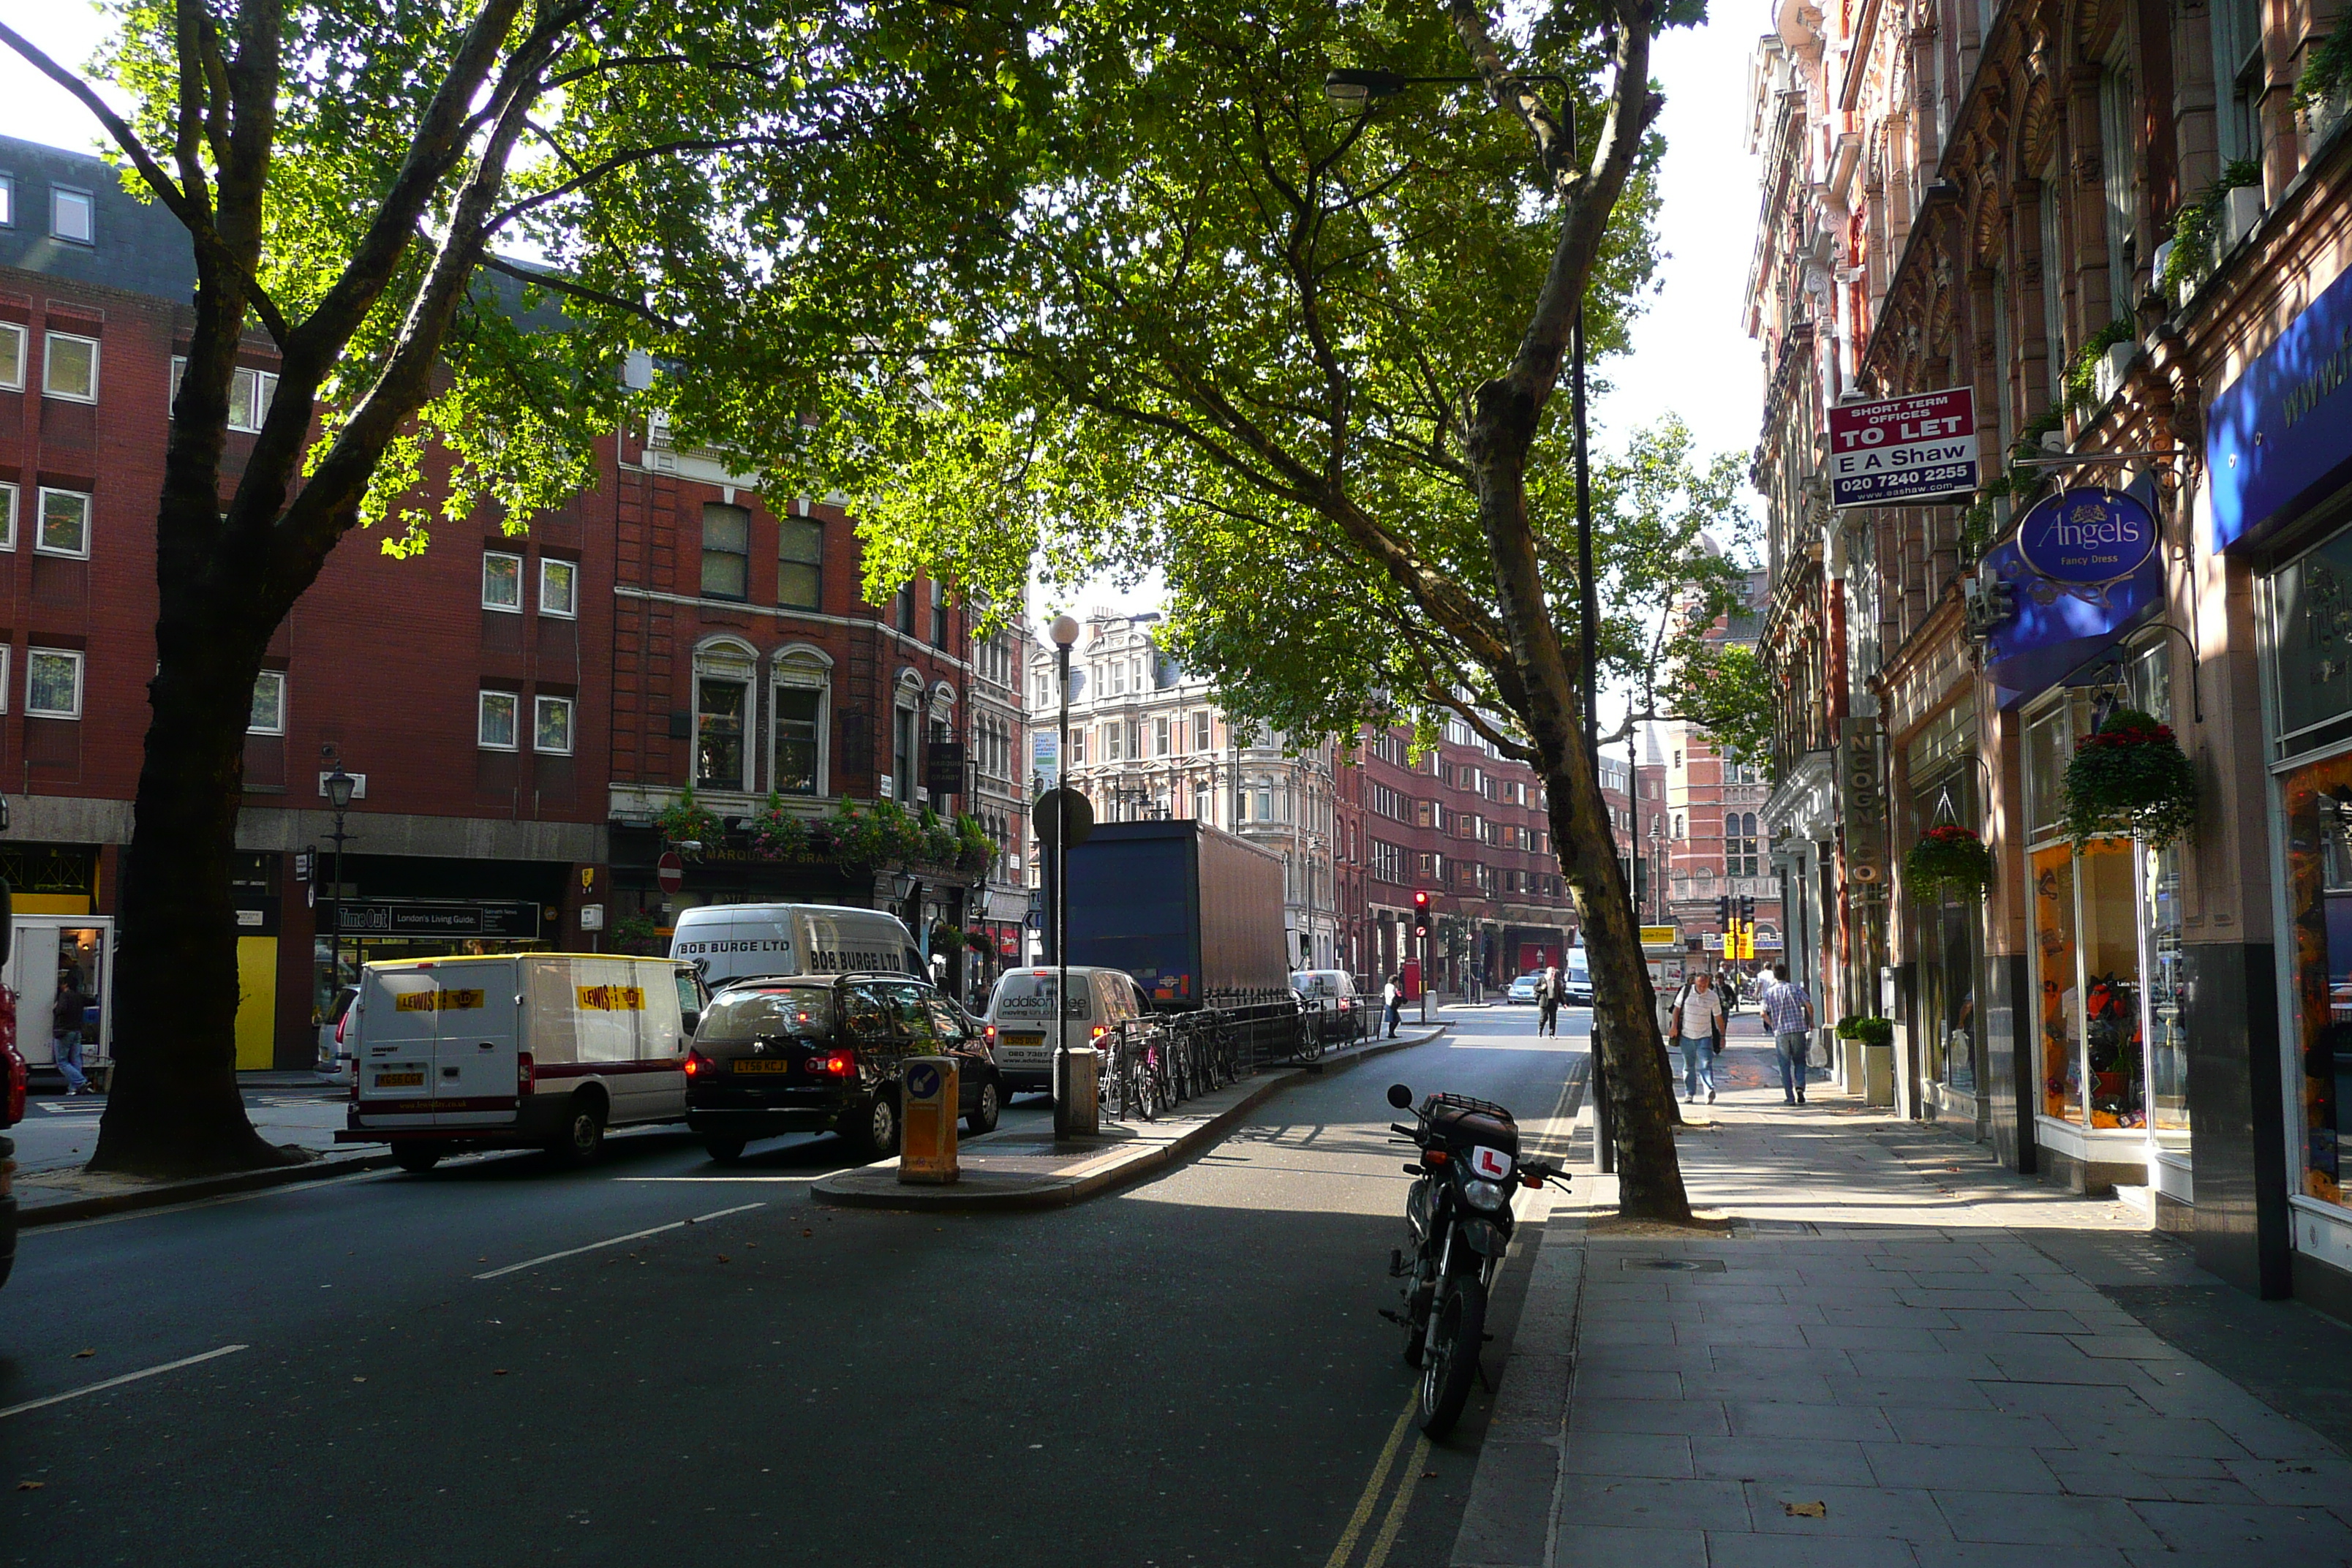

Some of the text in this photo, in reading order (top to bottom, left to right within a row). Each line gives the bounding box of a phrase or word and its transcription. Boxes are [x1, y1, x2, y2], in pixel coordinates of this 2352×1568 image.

[1851, 396, 1948, 418] SHORT TERM
[1869, 409, 1931, 424] OFFICES
[1839, 415, 1962, 448] TO LET
[1839, 445, 1966, 473] E A Shaw
[1842, 465, 1967, 492] 020 7240 2255
[1857, 483, 1953, 500] www.eashaw.com
[2036, 511, 2139, 550] Angels
[2061, 554, 2118, 566] Fancy Dress
[366, 908, 388, 928] Out
[397, 913, 429, 923] London's
[431, 914, 453, 925] Living
[680, 941, 790, 954] BOB BURGE LTD
[810, 951, 901, 971] BOB BURGE LTD
[403, 990, 434, 1011] LEWIS
[583, 984, 610, 1011] LEWIS
[1003, 995, 1053, 1008] addison
[738, 1061, 783, 1071] LT56 KCJ
[1481, 1150, 1502, 1175] L
